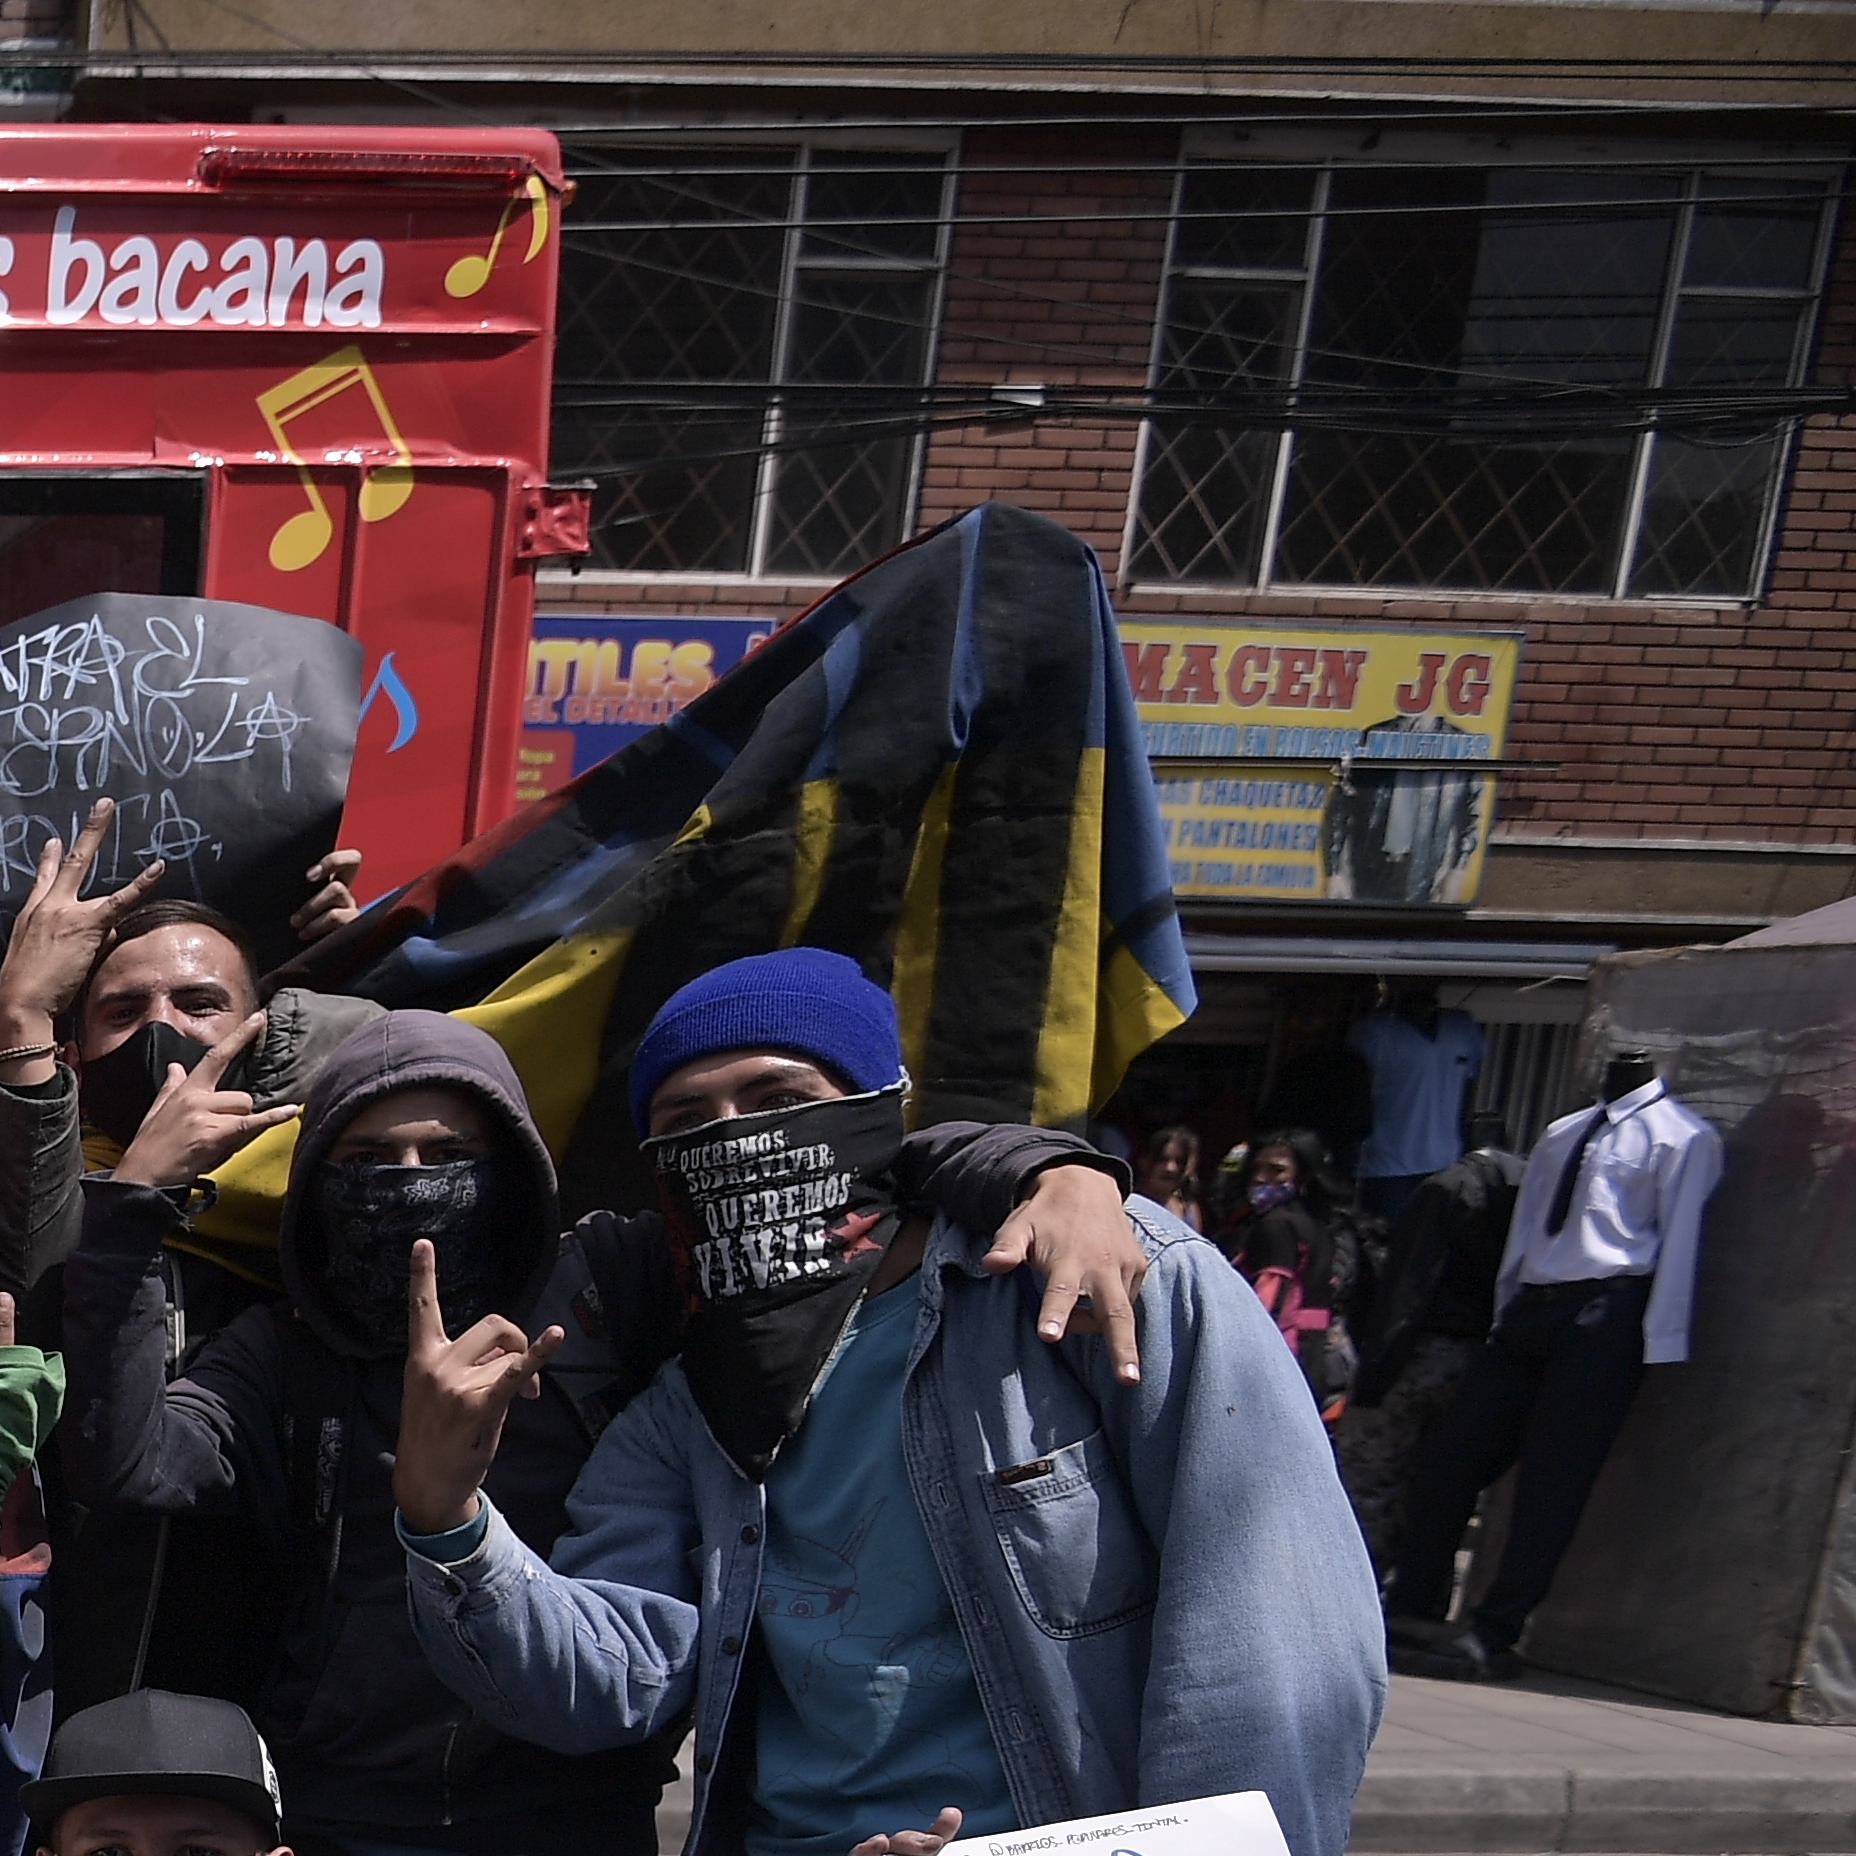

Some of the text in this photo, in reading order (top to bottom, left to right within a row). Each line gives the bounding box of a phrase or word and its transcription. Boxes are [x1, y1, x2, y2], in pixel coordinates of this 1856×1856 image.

[49, 205, 383, 330] bacana
[1121, 641, 1492, 717] MACEN JG
[1177, 818, 1319, 852] PANTALONES
[679, 1128, 787, 1174] QUEREMOS
[704, 1172, 852, 1239] QUEREMOS
